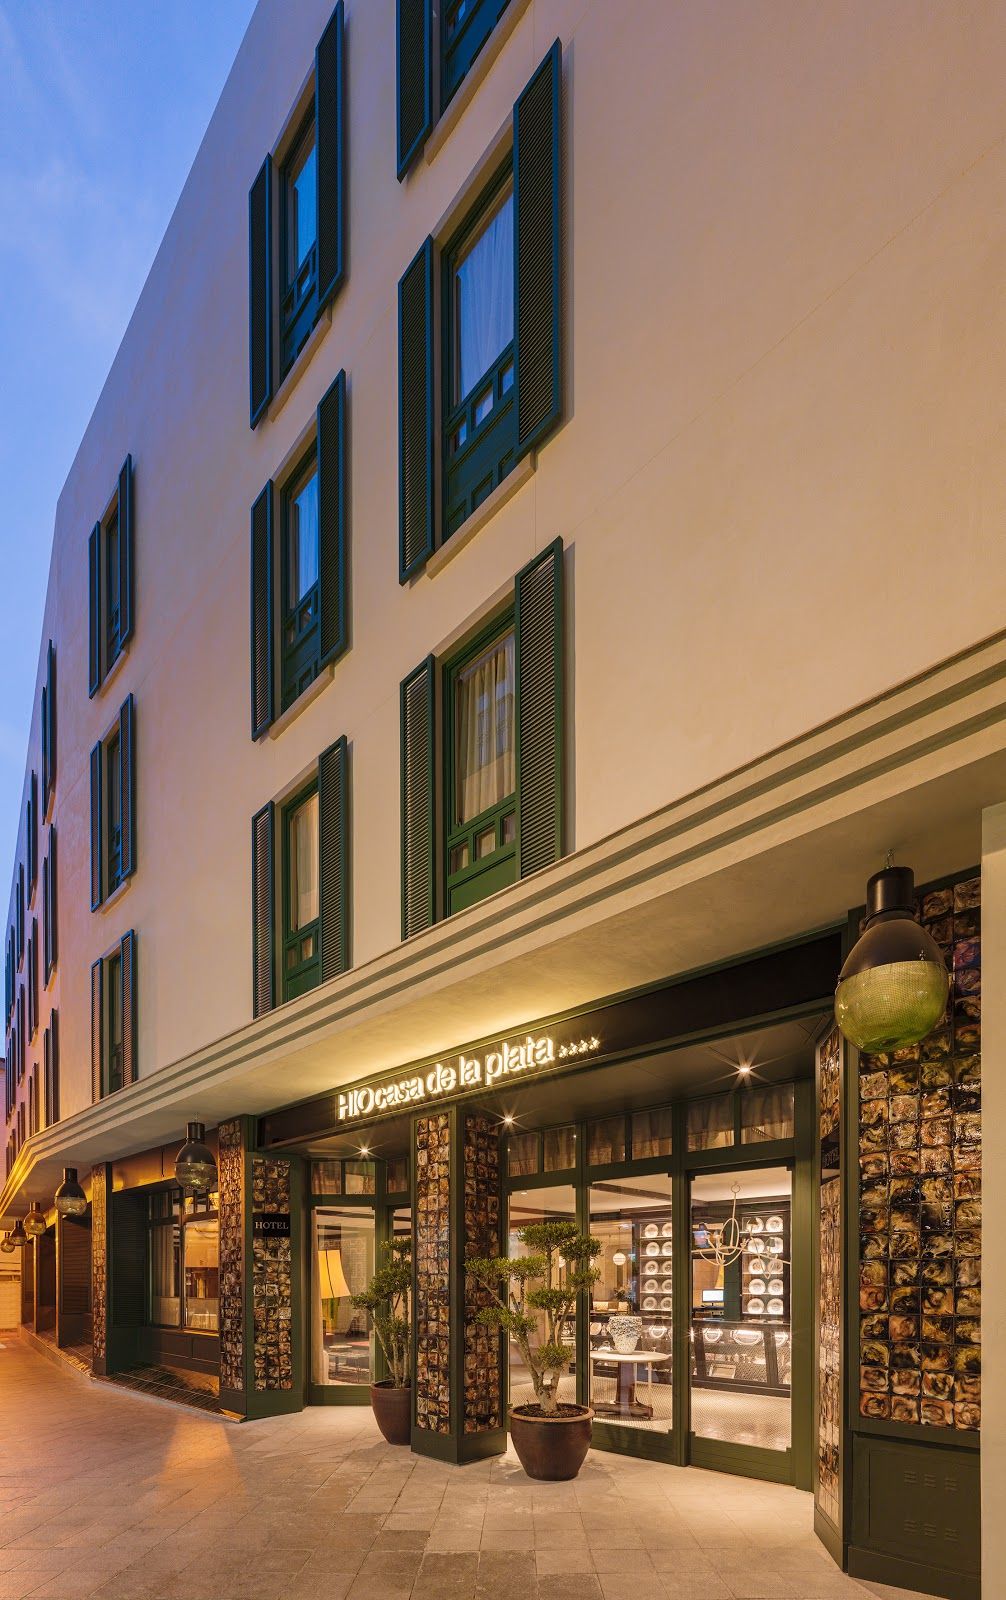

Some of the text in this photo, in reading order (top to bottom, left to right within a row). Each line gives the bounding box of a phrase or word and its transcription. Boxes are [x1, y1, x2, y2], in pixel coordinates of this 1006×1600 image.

[374, 1077, 425, 1109] casa
[426, 1063, 457, 1094] de
[459, 1055, 482, 1086] la
[485, 1036, 555, 1086] plata
[255, 1221, 289, 1230] HOTEL
